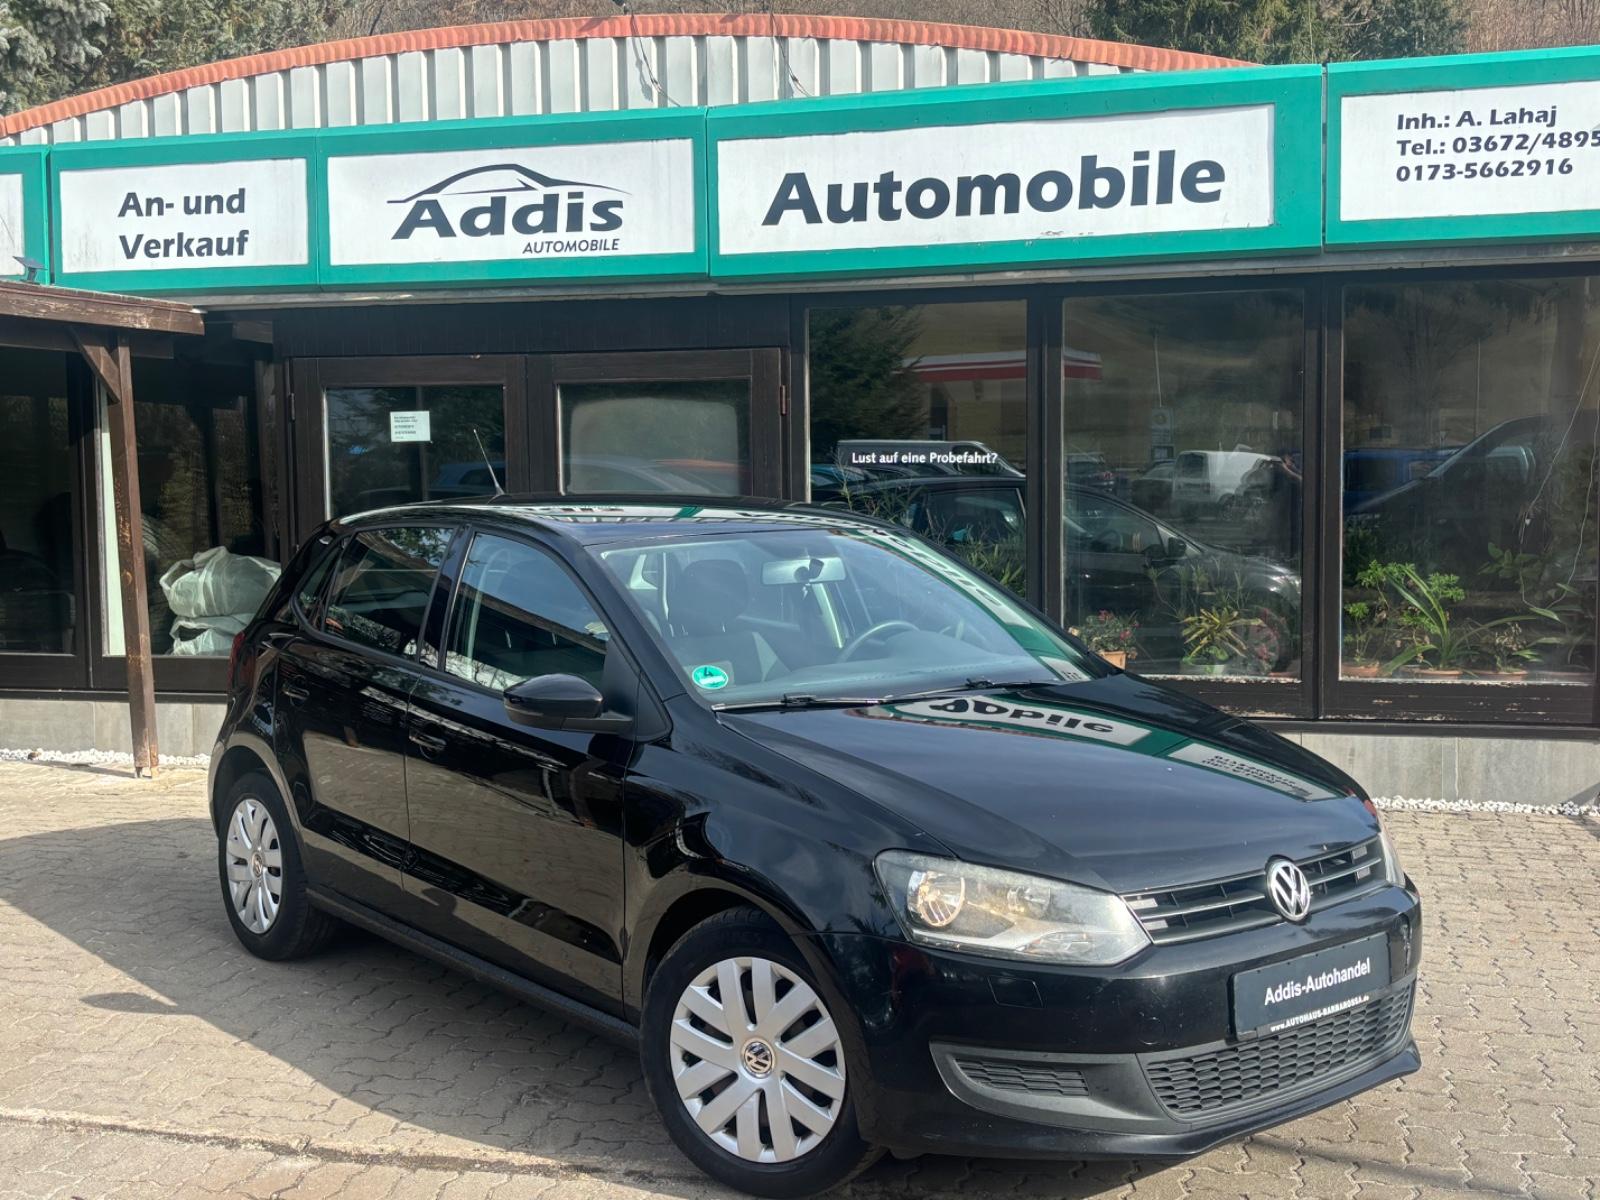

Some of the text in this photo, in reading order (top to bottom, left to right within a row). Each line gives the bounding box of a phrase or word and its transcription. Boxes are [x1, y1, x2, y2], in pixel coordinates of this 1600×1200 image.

[1397, 105, 1557, 130] Inh.: A. Lahaj
[1396, 139, 1446, 156] Tel.:
[1396, 158, 1573, 182] 0173-5662916
[761, 149, 1226, 226] Automobile
[118, 187, 246, 217] An- und
[391, 191, 624, 240] Addis
[119, 229, 249, 260] Verkauf
[522, 238, 620, 254] AUTOMOBILE
[852, 451, 998, 464] Lust auf eine Probefahrt?
[1264, 957, 1371, 1006] Addis-Autohandel
